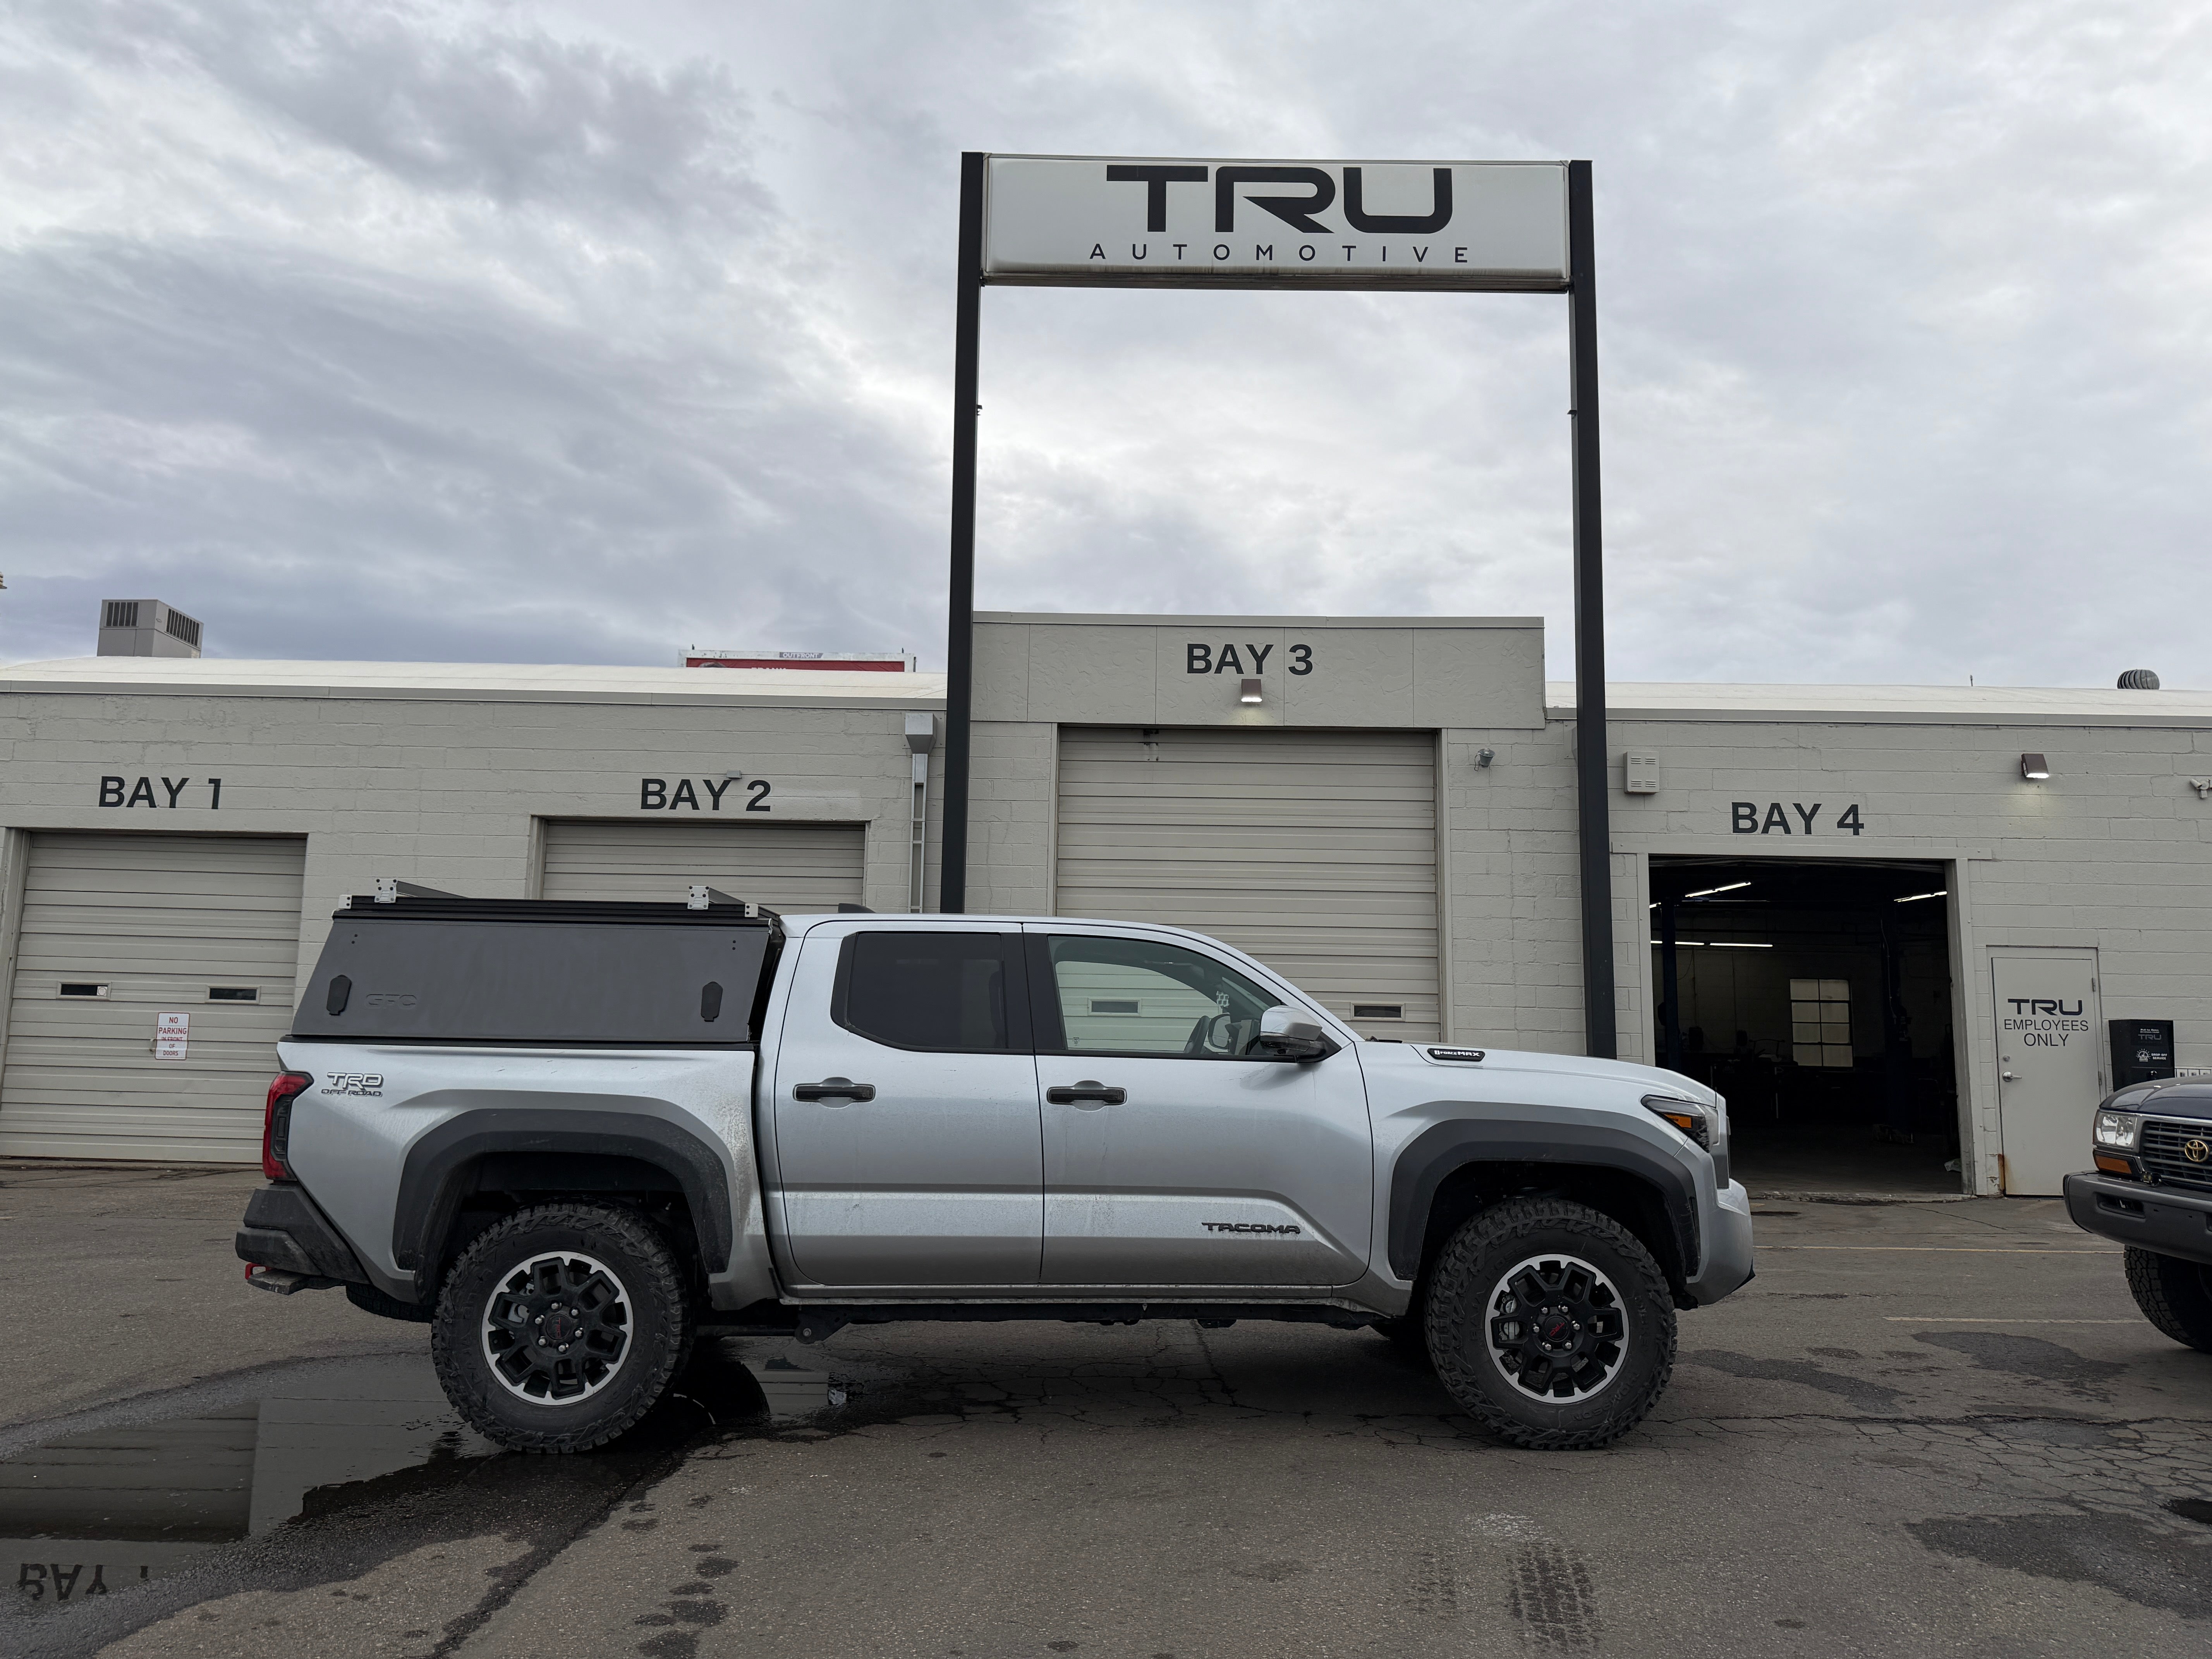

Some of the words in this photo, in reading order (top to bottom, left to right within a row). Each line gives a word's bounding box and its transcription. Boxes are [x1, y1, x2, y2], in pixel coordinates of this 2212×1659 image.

[1106, 165, 1453, 234] TRU
[1090, 244, 1468, 264] AUTOMOTIVE
[1186, 643, 1274, 675] BAY
[1288, 644, 1314, 676] 3
[99, 776, 190, 809] BAY
[208, 778, 222, 809] 1
[640, 778, 732, 811] BAY
[745, 780, 771, 812] 2
[1731, 802, 1822, 835] BAY
[1836, 804, 1865, 836] 4
[2007, 998, 2083, 1016] TRU
[2004, 1019, 2088, 1031] EMPLOYEES
[2024, 1032, 2069, 1046] ONLY
[327, 1072, 383, 1091] TRD
[1201, 1222, 1301, 1234] TACOMA
[1549, 1322, 1565, 1337] TRD
